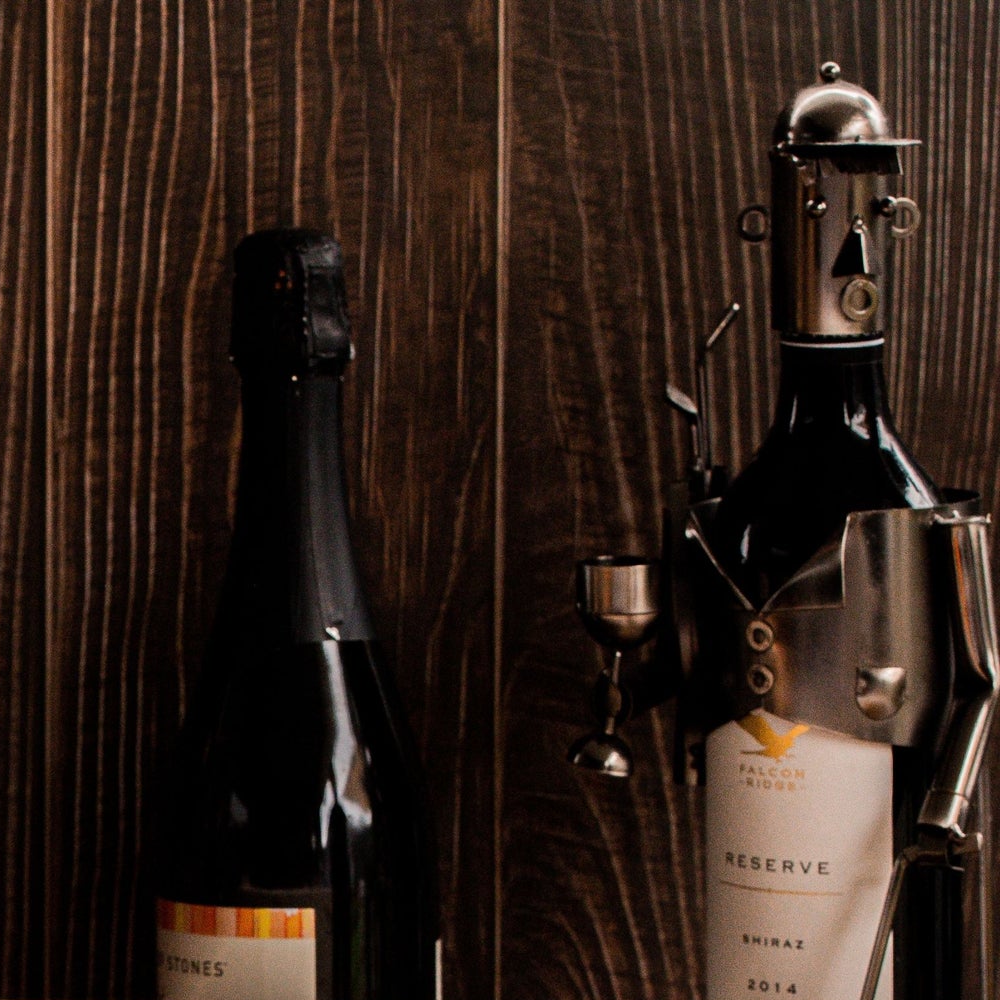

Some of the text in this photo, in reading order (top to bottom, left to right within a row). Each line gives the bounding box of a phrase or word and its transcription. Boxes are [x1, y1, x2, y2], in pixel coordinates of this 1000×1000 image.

[725, 851, 830, 875] RESERVE
[743, 933, 804, 950] SHIRAZ
[747, 978, 797, 995] 2014
